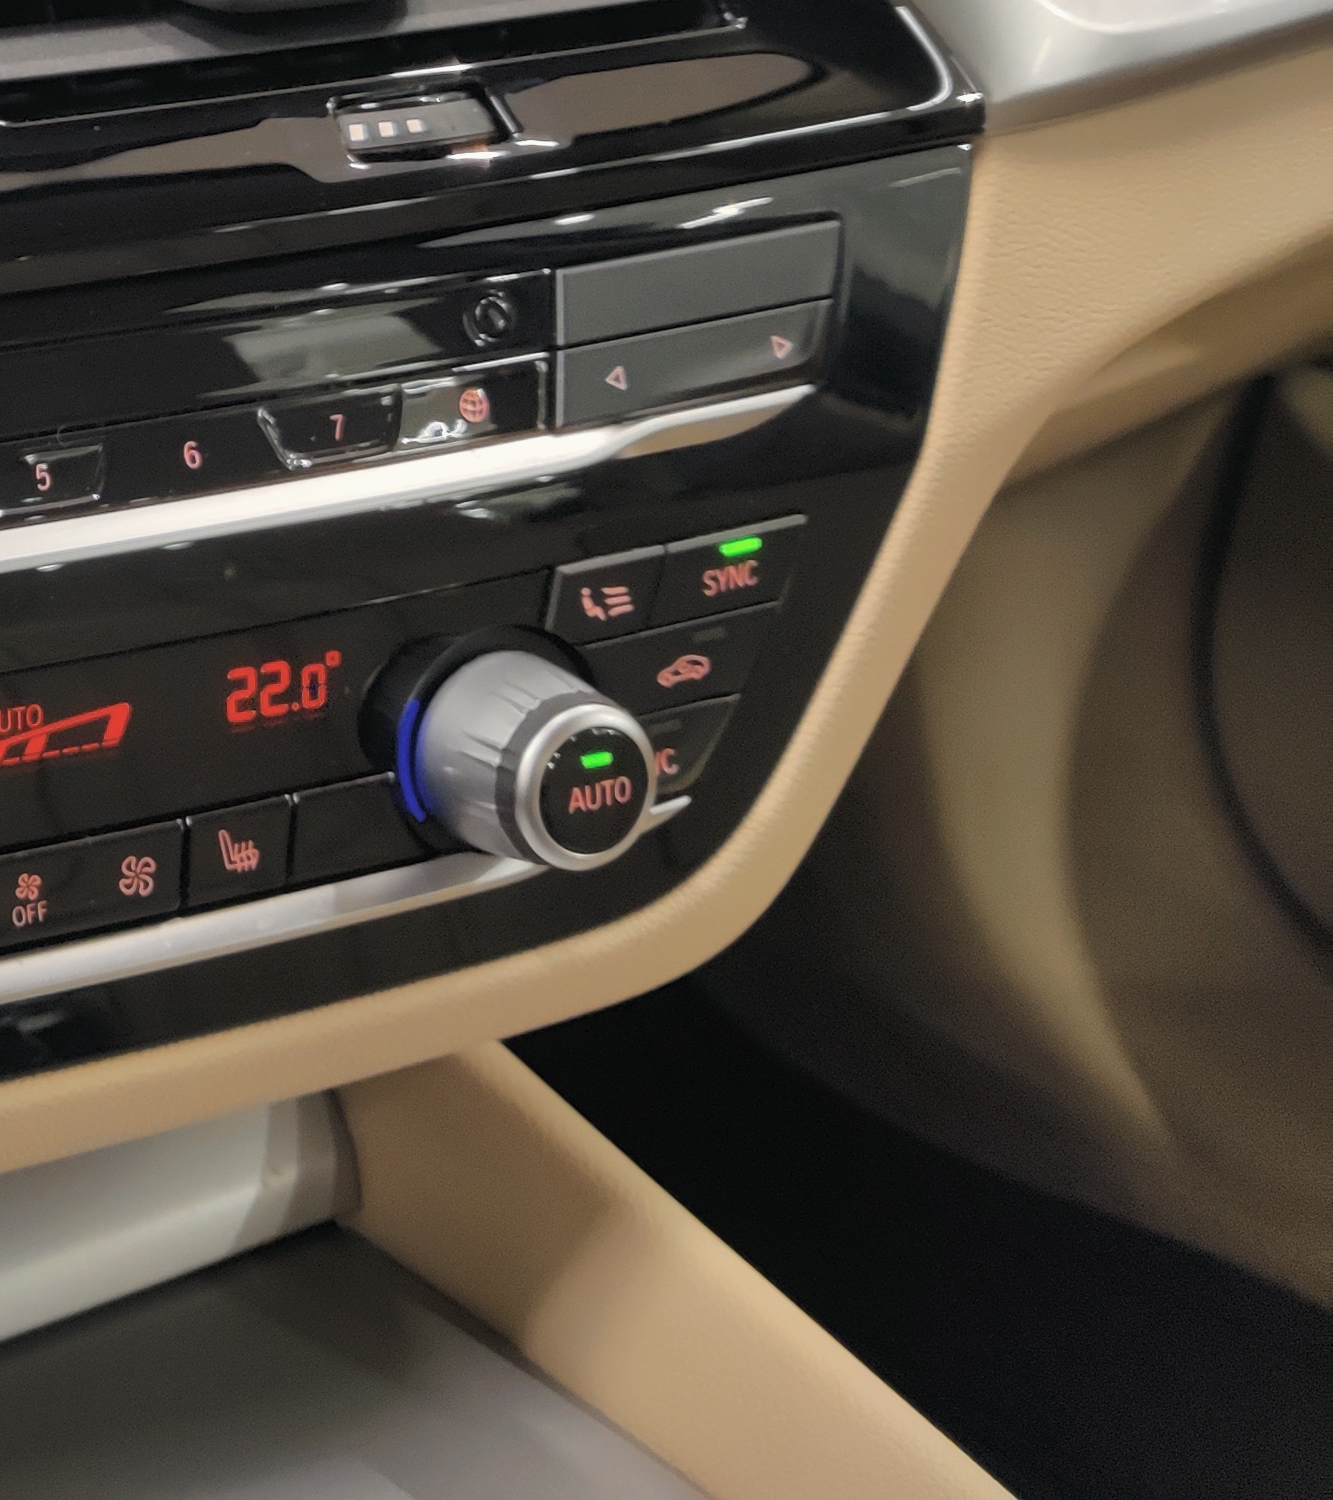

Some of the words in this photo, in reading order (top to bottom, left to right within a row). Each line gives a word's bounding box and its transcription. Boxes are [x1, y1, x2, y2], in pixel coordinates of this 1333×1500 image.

[329, 414, 345, 441] 7
[183, 440, 202, 470] 6
[35, 463, 52, 492] 5
[702, 559, 759, 597] SYNC
[568, 775, 632, 813] AUTO
[12, 900, 48, 927] OFF
